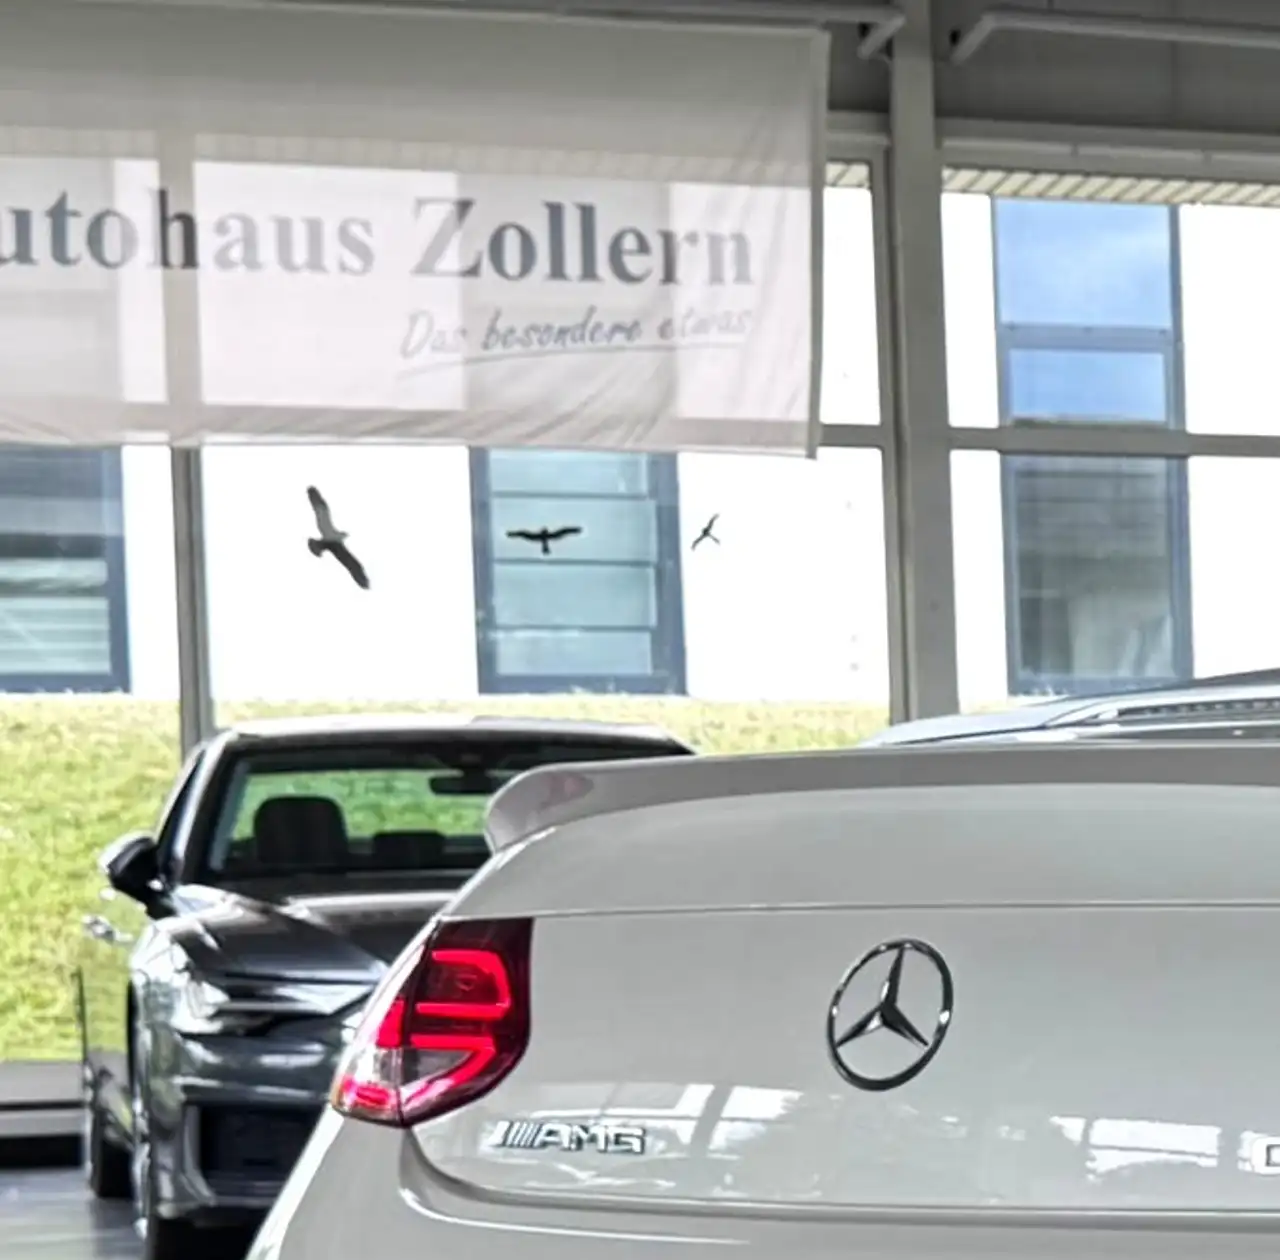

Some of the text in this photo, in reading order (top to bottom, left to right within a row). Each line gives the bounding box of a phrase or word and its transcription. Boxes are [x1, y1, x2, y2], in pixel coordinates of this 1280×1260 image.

[409, 197, 754, 286] Zollern
[481, 304, 643, 351] besondere
[657, 306, 753, 341] etwas
